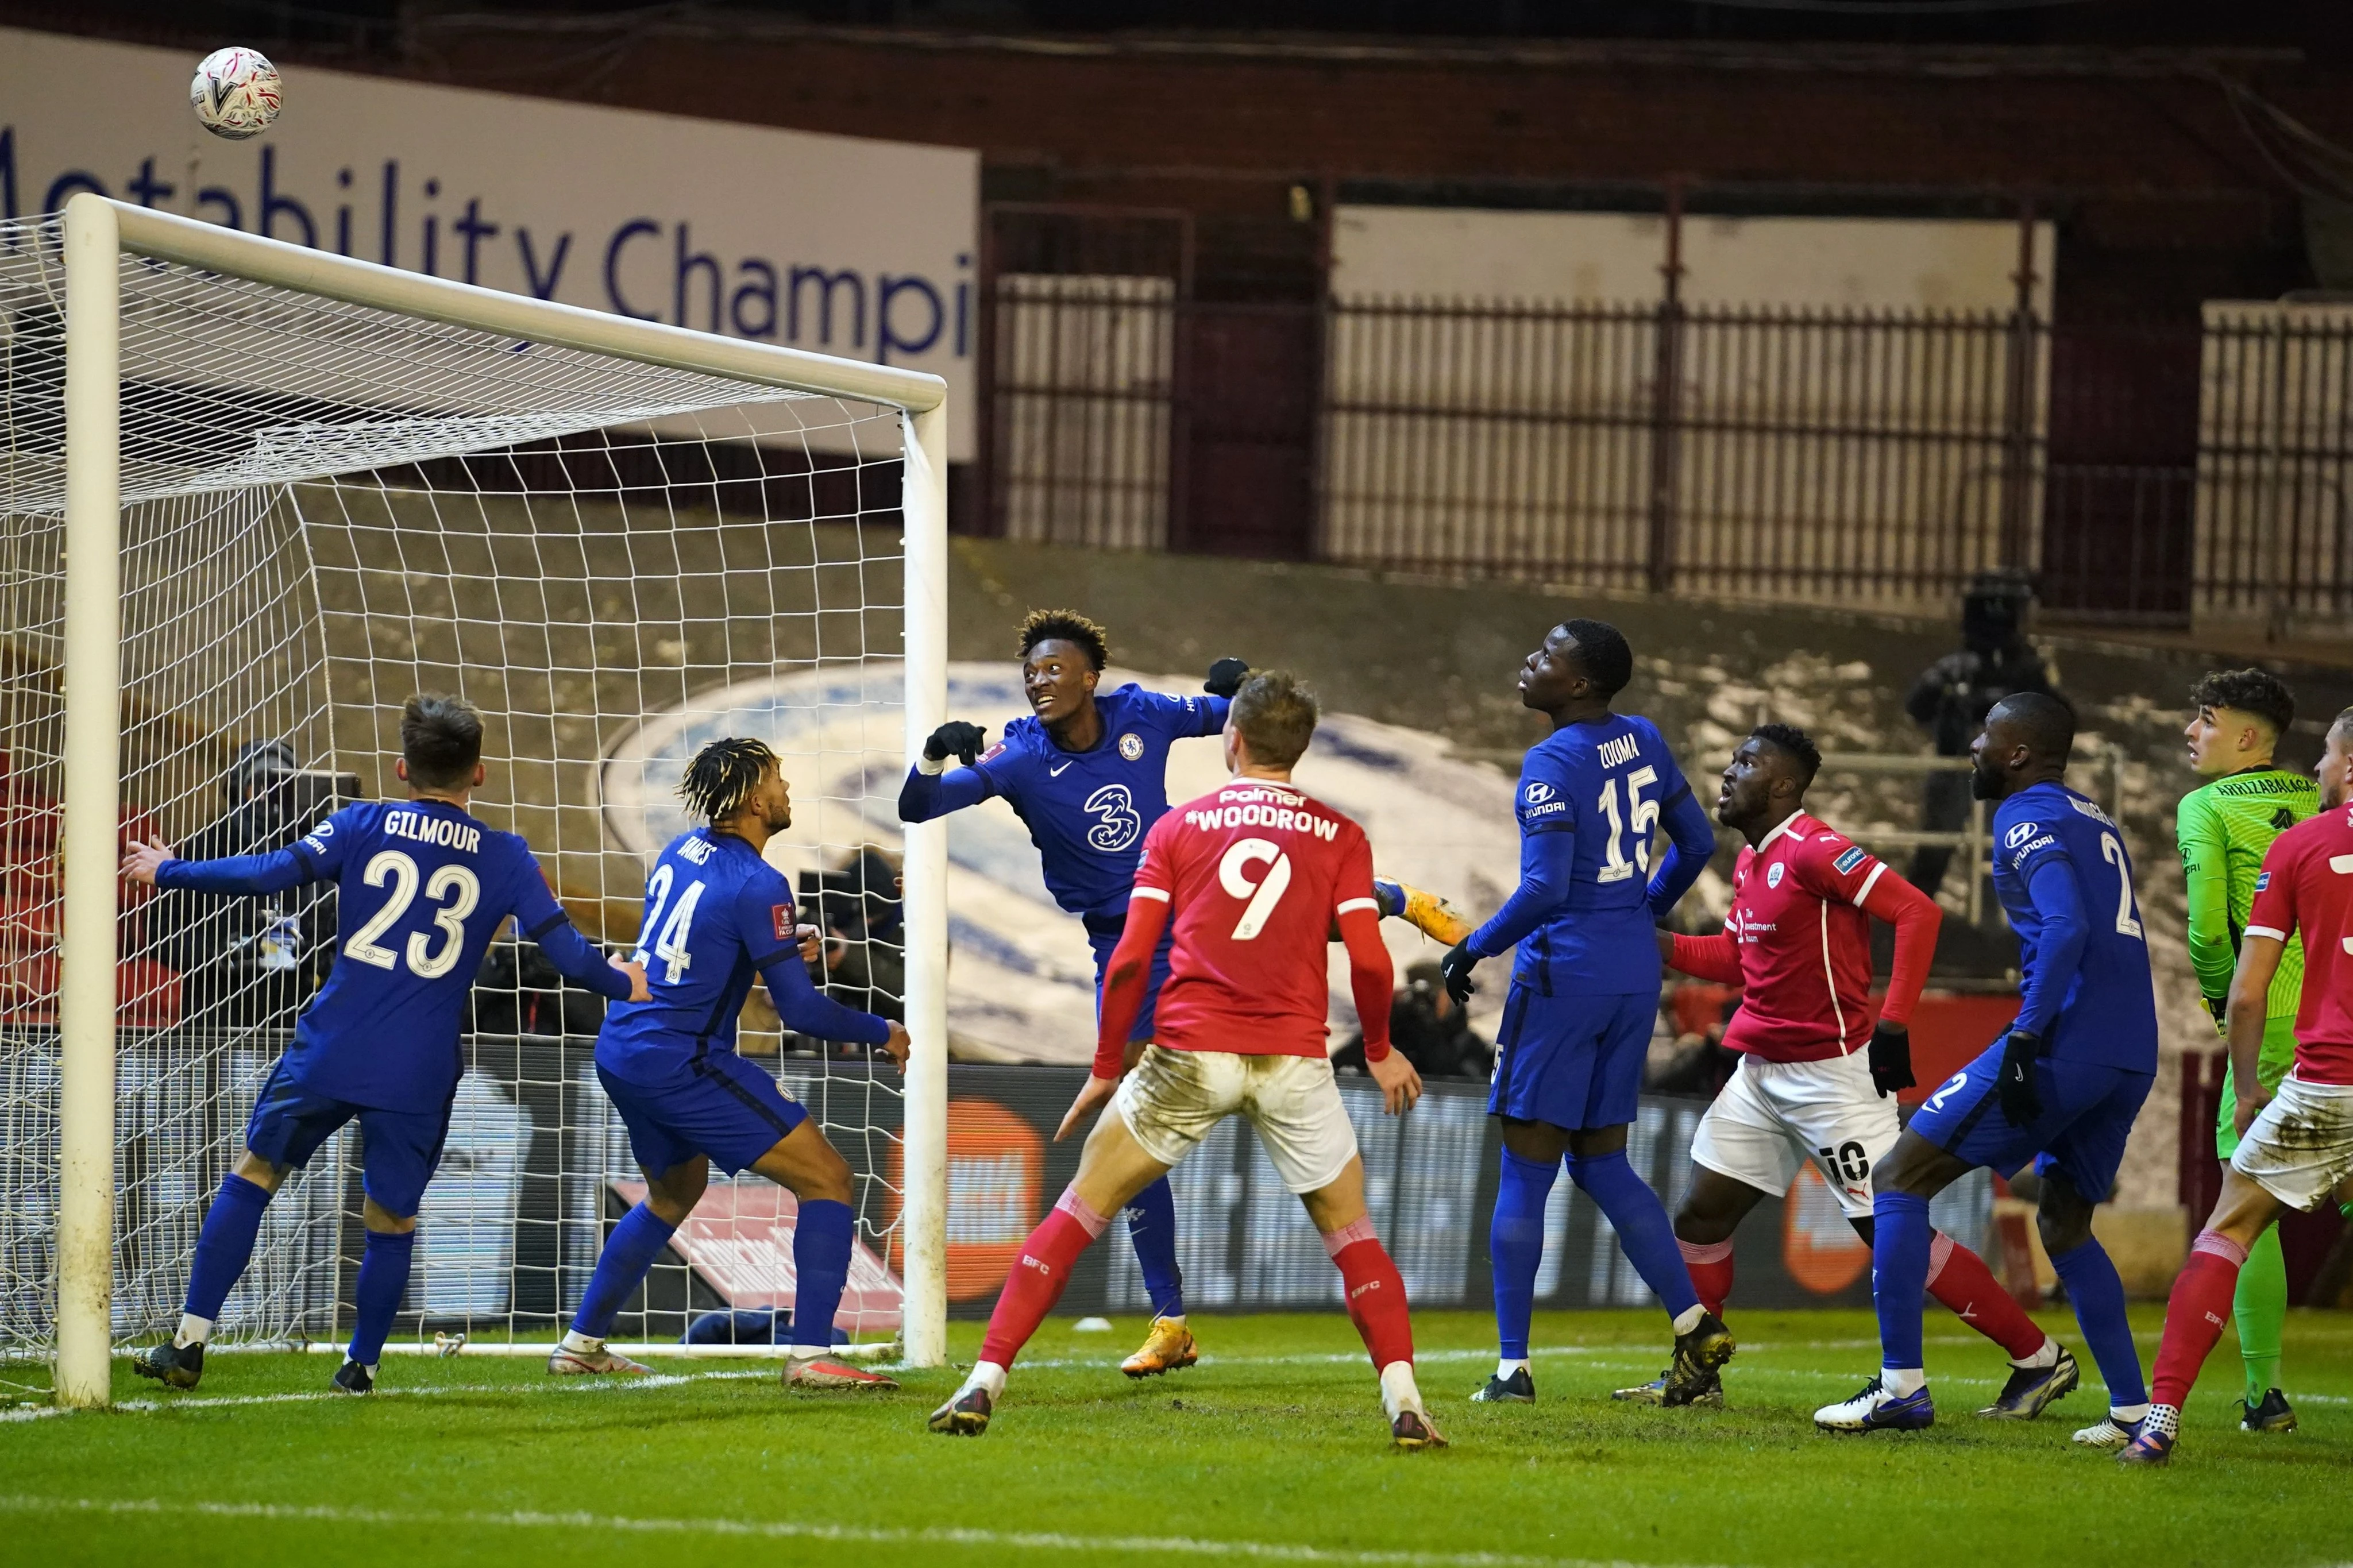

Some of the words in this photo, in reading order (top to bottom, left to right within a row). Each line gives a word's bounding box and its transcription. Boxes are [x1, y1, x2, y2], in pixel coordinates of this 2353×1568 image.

[1597, 733, 1640, 769] ZOUMA
[1198, 804, 1339, 842] WOODROW
[1525, 801, 1566, 820] HYUNDAI
[1597, 764, 1660, 883] 15
[384, 810, 481, 854] GILMOUR
[2012, 834, 2055, 870] HYUNDAI
[1218, 837, 1292, 941] 9
[2100, 831, 2143, 941] 2
[344, 849, 481, 979] 23
[631, 863, 707, 985] 24
[1931, 1072, 1968, 1110] 2
[1818, 1141, 1869, 1185] 10
[1022, 1254, 1050, 1276] BFC
[1351, 1280, 1380, 1299] BFC
